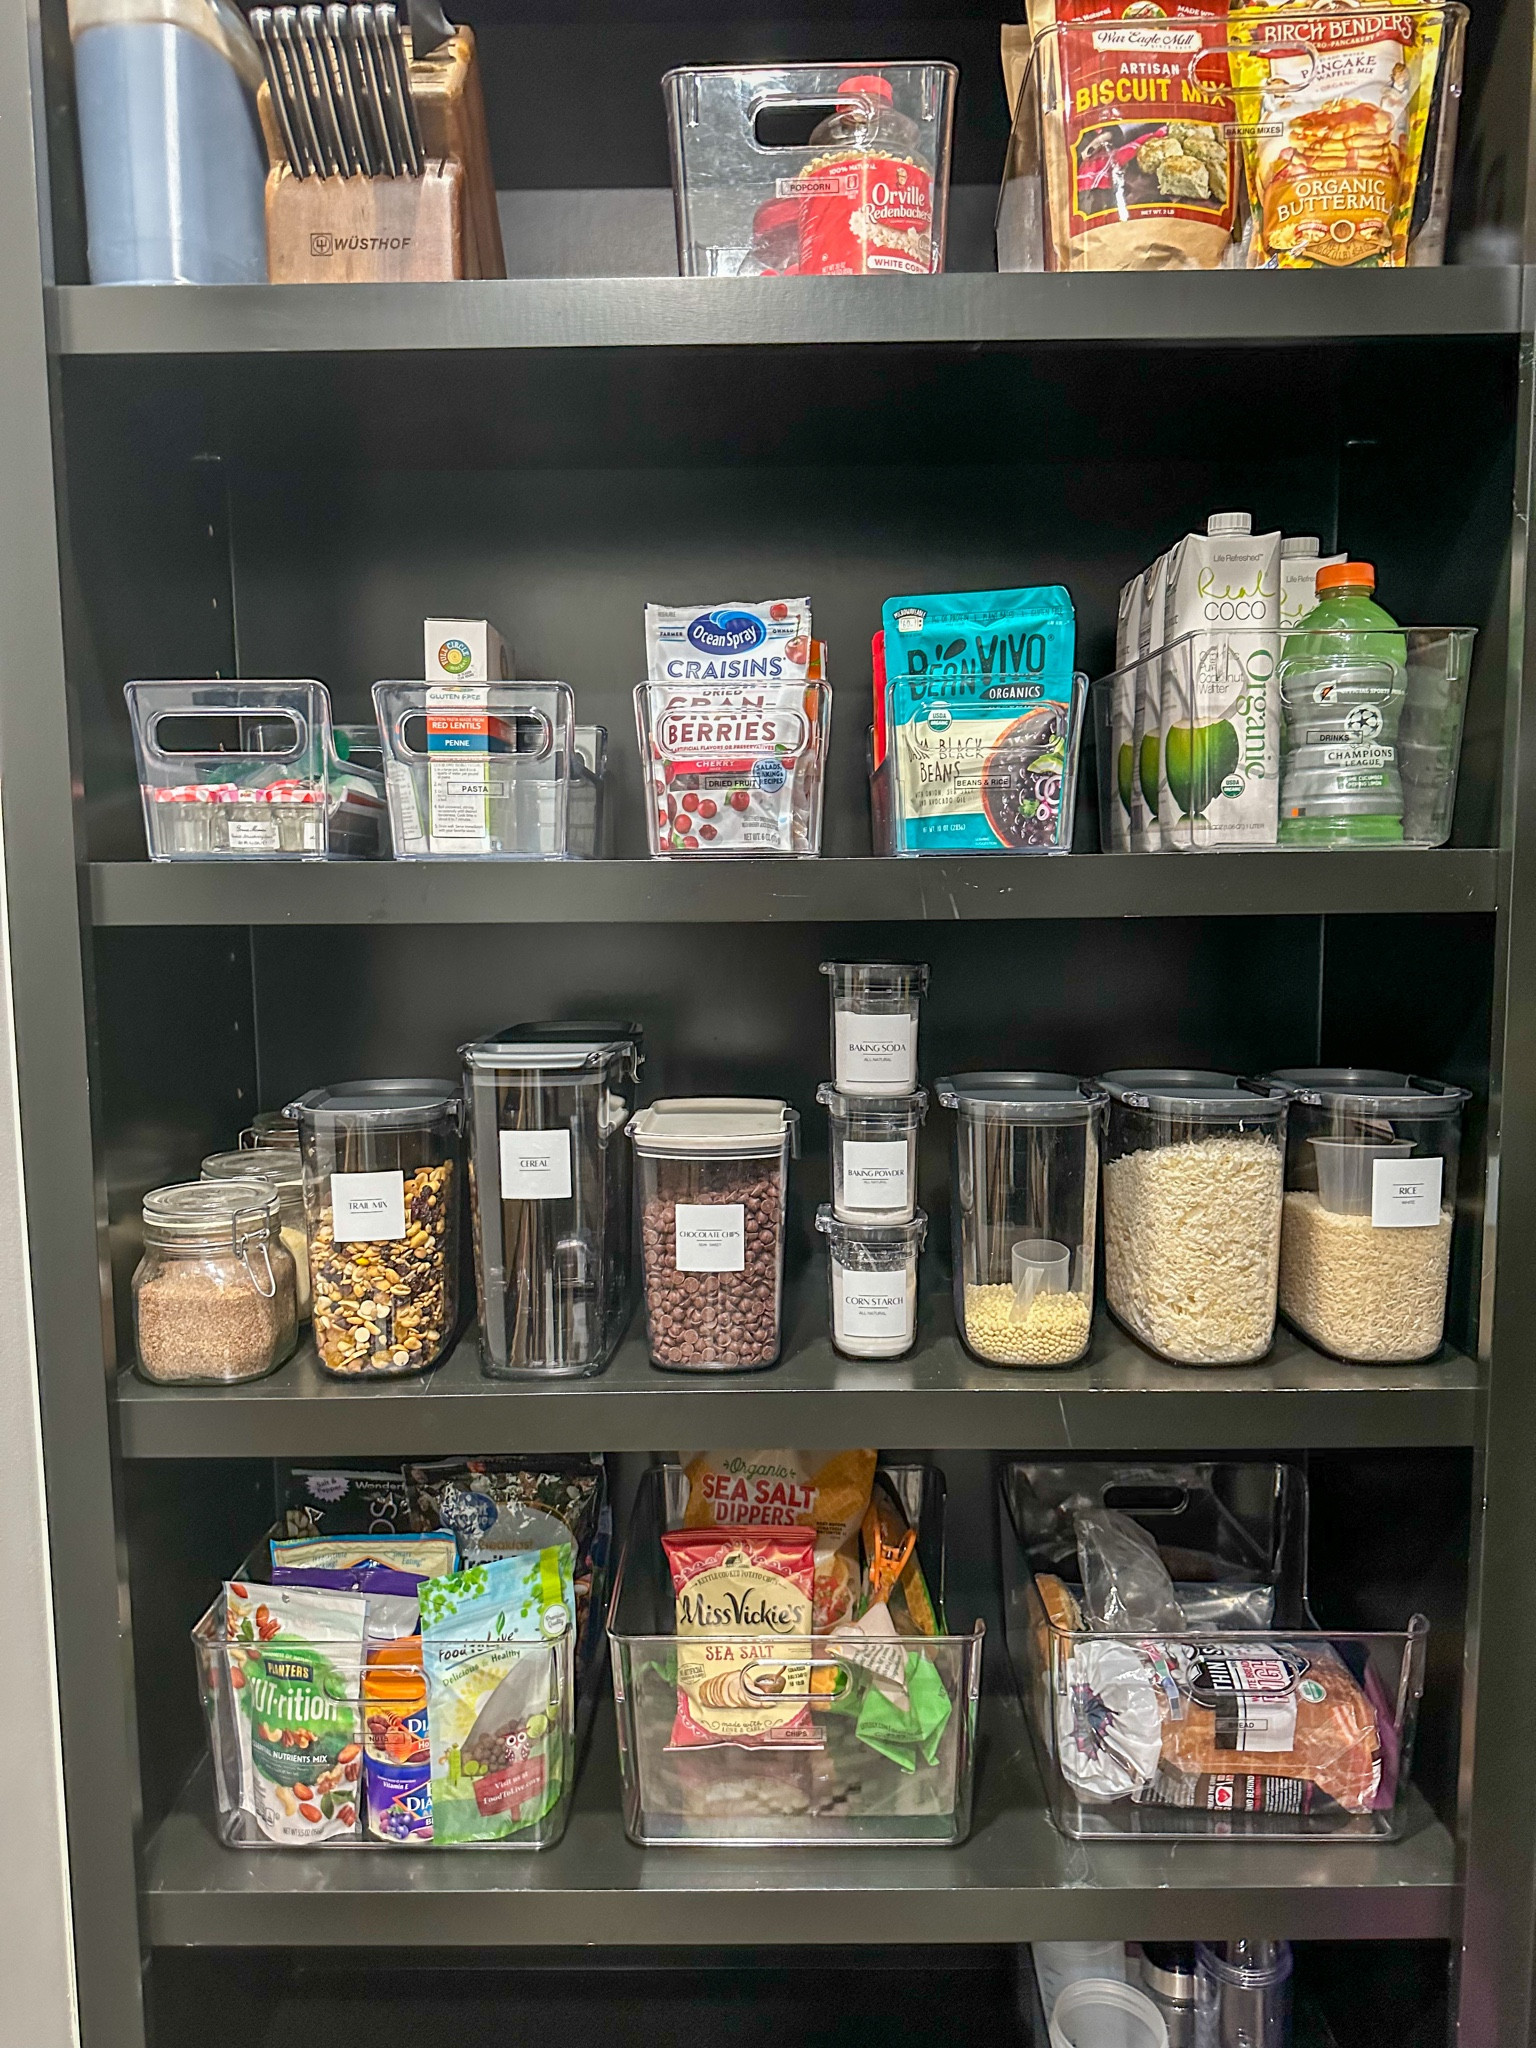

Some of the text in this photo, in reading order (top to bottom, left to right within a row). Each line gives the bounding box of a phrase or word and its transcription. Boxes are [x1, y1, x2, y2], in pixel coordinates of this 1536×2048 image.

[1177, 5, 1199, 16] MADE
[1265, 15, 1413, 42] BIRCH BENDERS
[1098, 32, 1125, 43] War
[1128, 31, 1161, 47] Eagle
[1120, 62, 1180, 75] ARTISAN
[1075, 78, 1226, 113] BISCUIT MIX
[1225, 126, 1281, 137] BAKING MIXES
[790, 183, 831, 192] POPCORN
[872, 182, 925, 207] Orville
[1295, 178, 1386, 197] ORGANIC
[864, 203, 931, 224] Redenbacher's
[335, 235, 411, 250] WÜSTHOF
[874, 258, 903, 268] WHITE
[1213, 554, 1225, 562] Life
[1198, 567, 1275, 600] Real
[1204, 601, 1266, 620] COCO
[693, 625, 757, 649] Ocean Spray
[446, 641, 470, 657] CIRCLE
[667, 656, 783, 679] CRAISINS
[989, 685, 1041, 699] ORGANICS
[1235, 649, 1274, 780] Organic
[450, 722, 481, 730] LENTILS
[668, 720, 776, 745] BERRIES
[444, 739, 470, 747] PENNE
[1328, 749, 1393, 761] CHAMPIONS
[920, 761, 960, 783] BEANS
[462, 785, 488, 793] PASTA
[734, 779, 757, 787] FRUIT
[956, 779, 982, 787] BEANS
[849, 1043, 906, 1052] BAKING SODA
[1399, 1187, 1417, 1195] RICE
[348, 1202, 369, 1210] TRAIL
[845, 1296, 904, 1306] CORN STARCH
[730, 1457, 788, 1480] Organic
[702, 1474, 816, 1509] SEA SALT
[716, 1502, 795, 1526] DIPPERS
[680, 1588, 803, 1633] Miss Vickie's
[491, 1650, 520, 1664] Healthy
[706, 1645, 774, 1660] SEA SALT
[268, 1662, 309, 1679] PLANTERS
[442, 1663, 479, 1688] Delicious
[1206, 1662, 1232, 1690] THIN
[272, 1751, 328, 1763] NUTRIENTS MIX
[495, 1779, 512, 1790] Visit
[1246, 1776, 1254, 1798] BEHIND
